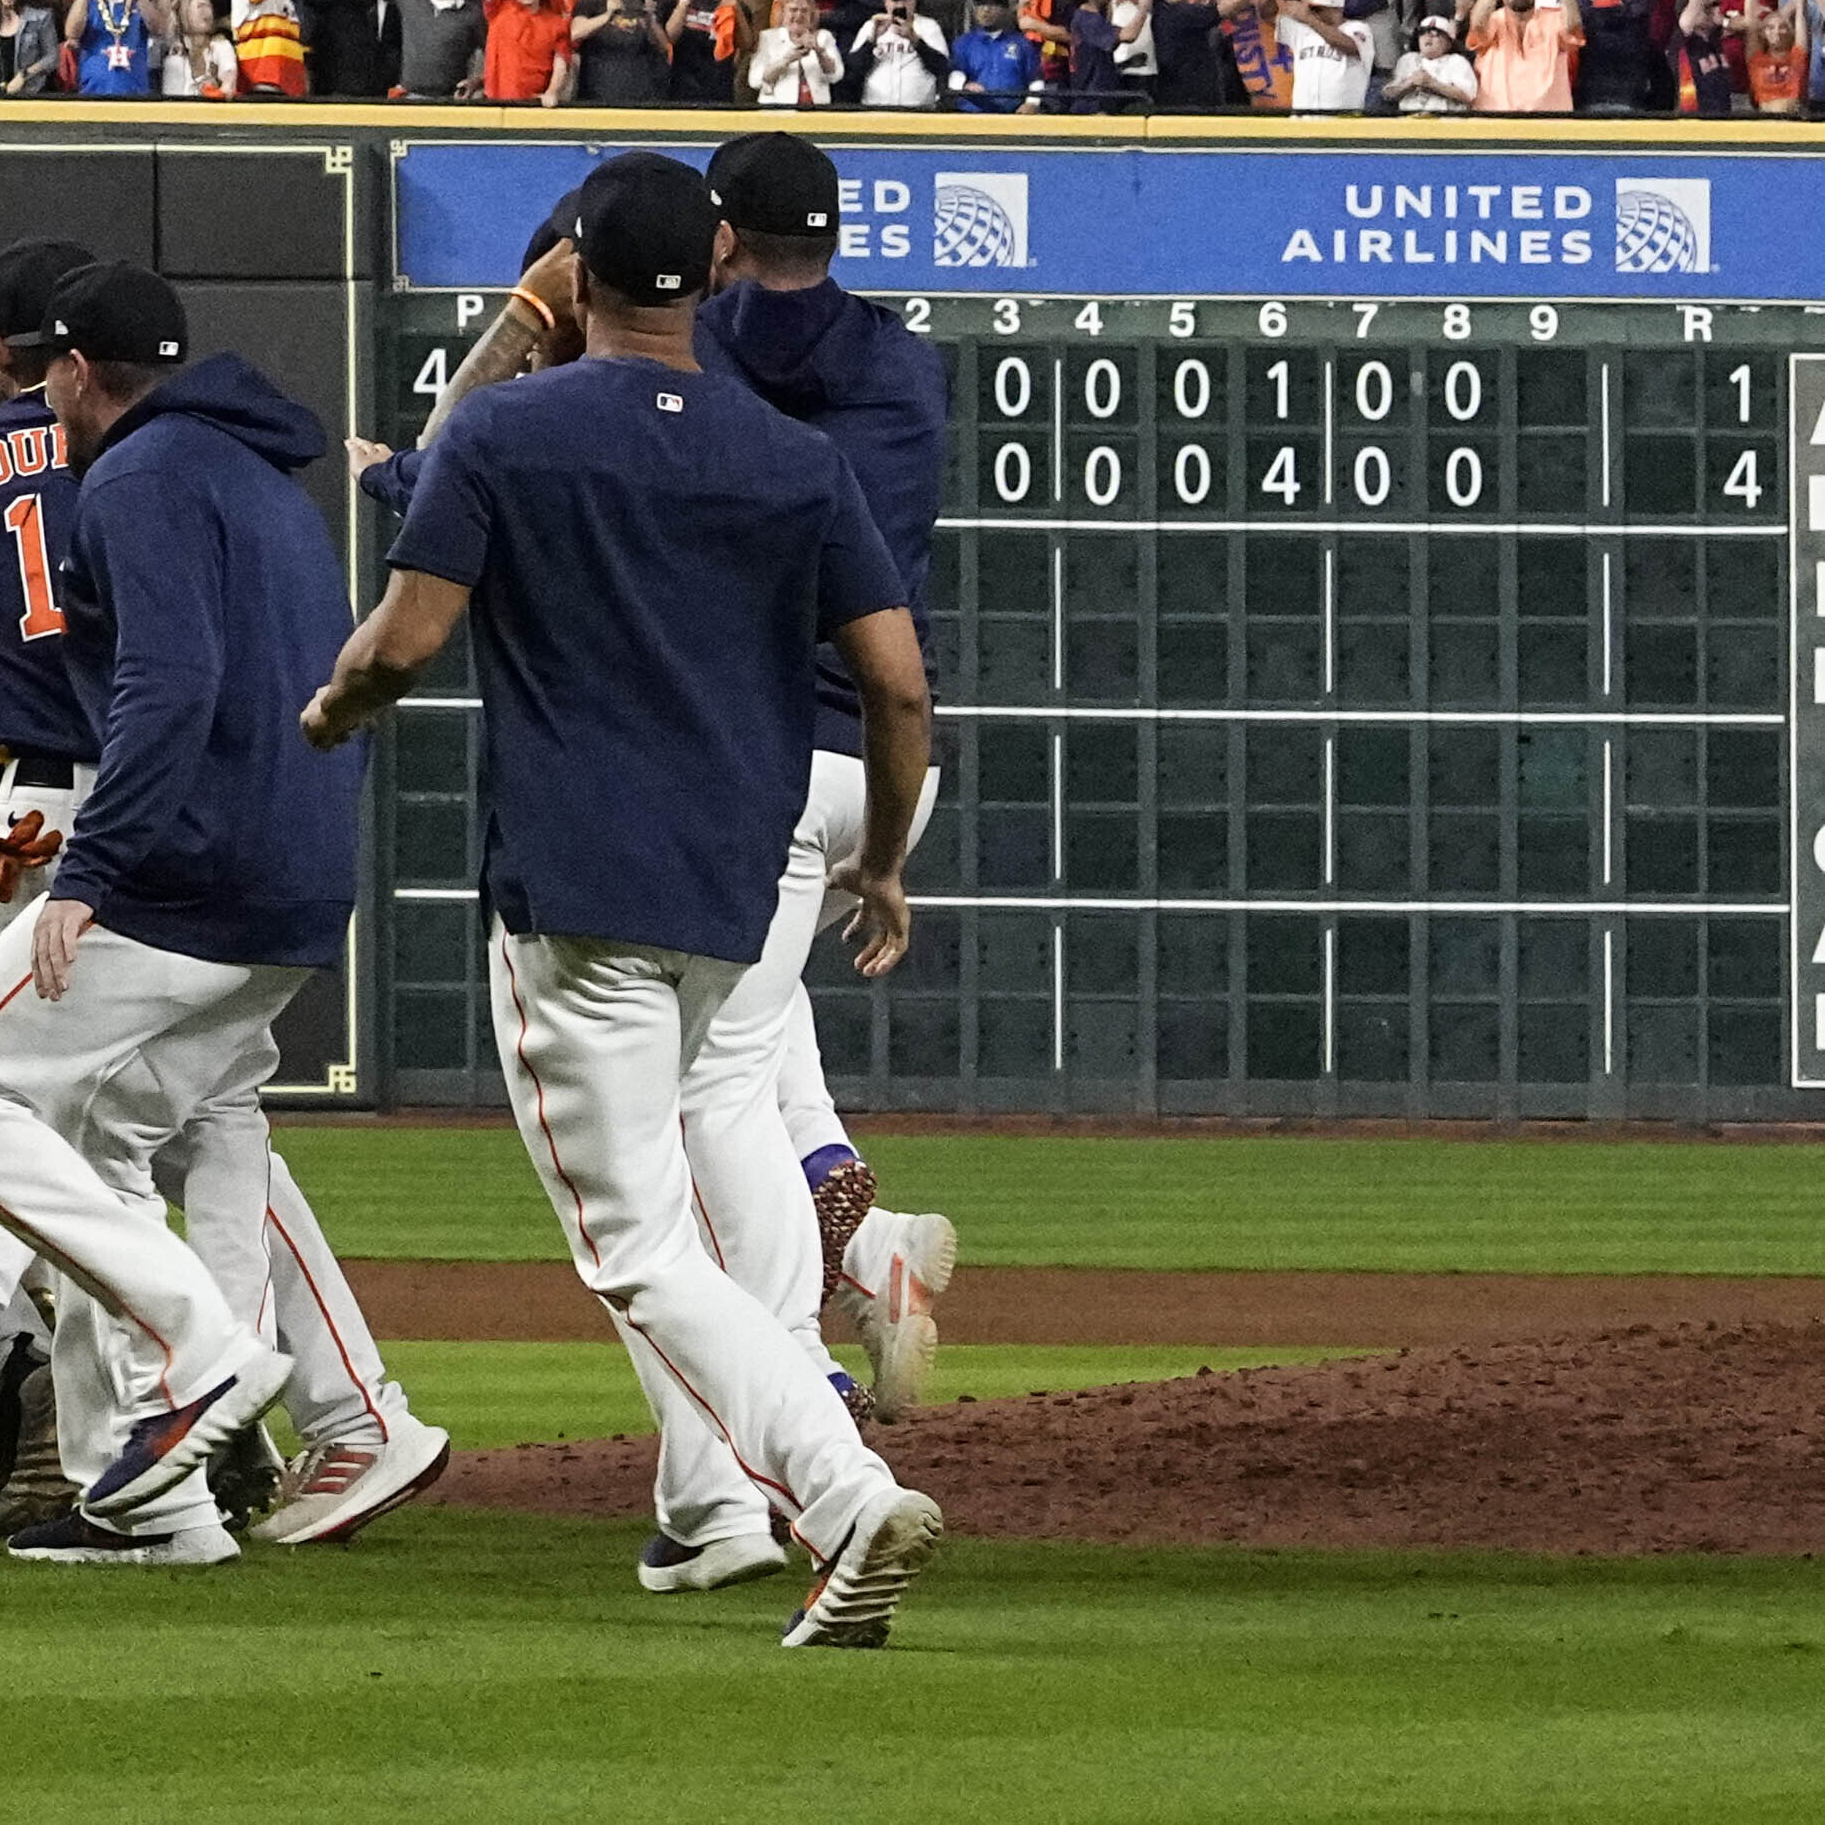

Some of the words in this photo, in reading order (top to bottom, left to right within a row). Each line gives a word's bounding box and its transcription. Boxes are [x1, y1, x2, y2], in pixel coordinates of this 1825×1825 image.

[1345, 184, 1592, 220] UNITED
[1281, 229, 1594, 264] AIRLINES
[457, 294, 485, 328] P
[905, 297, 932, 333] 2
[993, 298, 1021, 335] 3
[1075, 300, 1104, 336] 4
[1168, 301, 1195, 338] 5
[1258, 301, 1288, 338] 6
[1352, 303, 1379, 339] 7
[1442, 303, 1472, 340] 8
[1529, 304, 1559, 342] 9
[1684, 305, 1713, 343] R
[995, 357, 1031, 417] 0
[1085, 359, 1121, 418] 0
[1174, 359, 1210, 418] 0
[1267, 360, 1288, 419] 1
[1356, 361, 1392, 420] 0
[1445, 361, 1481, 421] 0
[1729, 364, 1750, 422] 1
[994, 442, 1031, 502] 0
[1085, 446, 1121, 506] 0
[1175, 444, 1211, 504] 0
[1261, 447, 1301, 505] 4
[1354, 446, 1390, 506] 0
[1446, 447, 1482, 507] 0
[1723, 450, 1762, 509] 4
[3, 493, 70, 642] 1
